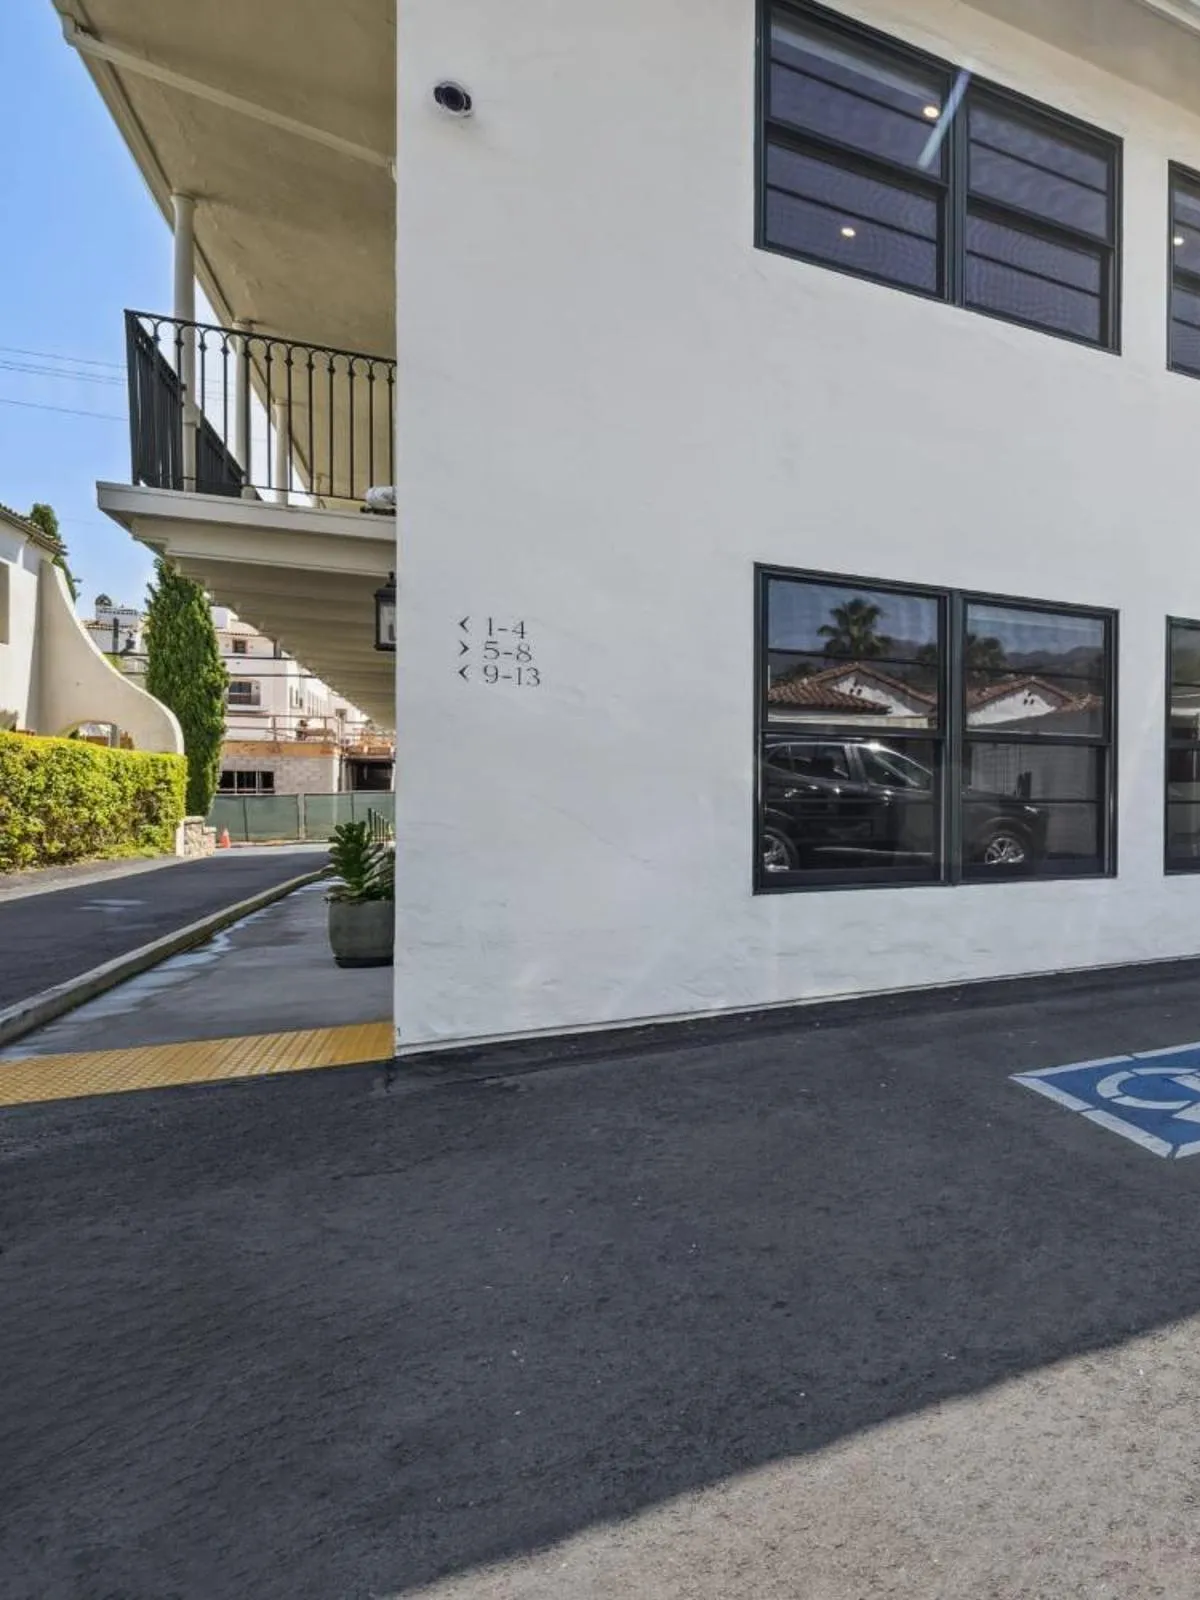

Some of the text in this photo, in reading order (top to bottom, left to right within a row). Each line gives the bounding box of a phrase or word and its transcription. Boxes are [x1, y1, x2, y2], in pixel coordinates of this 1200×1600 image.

[488, 617, 527, 639] 1-4
[483, 640, 532, 662] 5-8
[483, 664, 541, 687] 9-13
